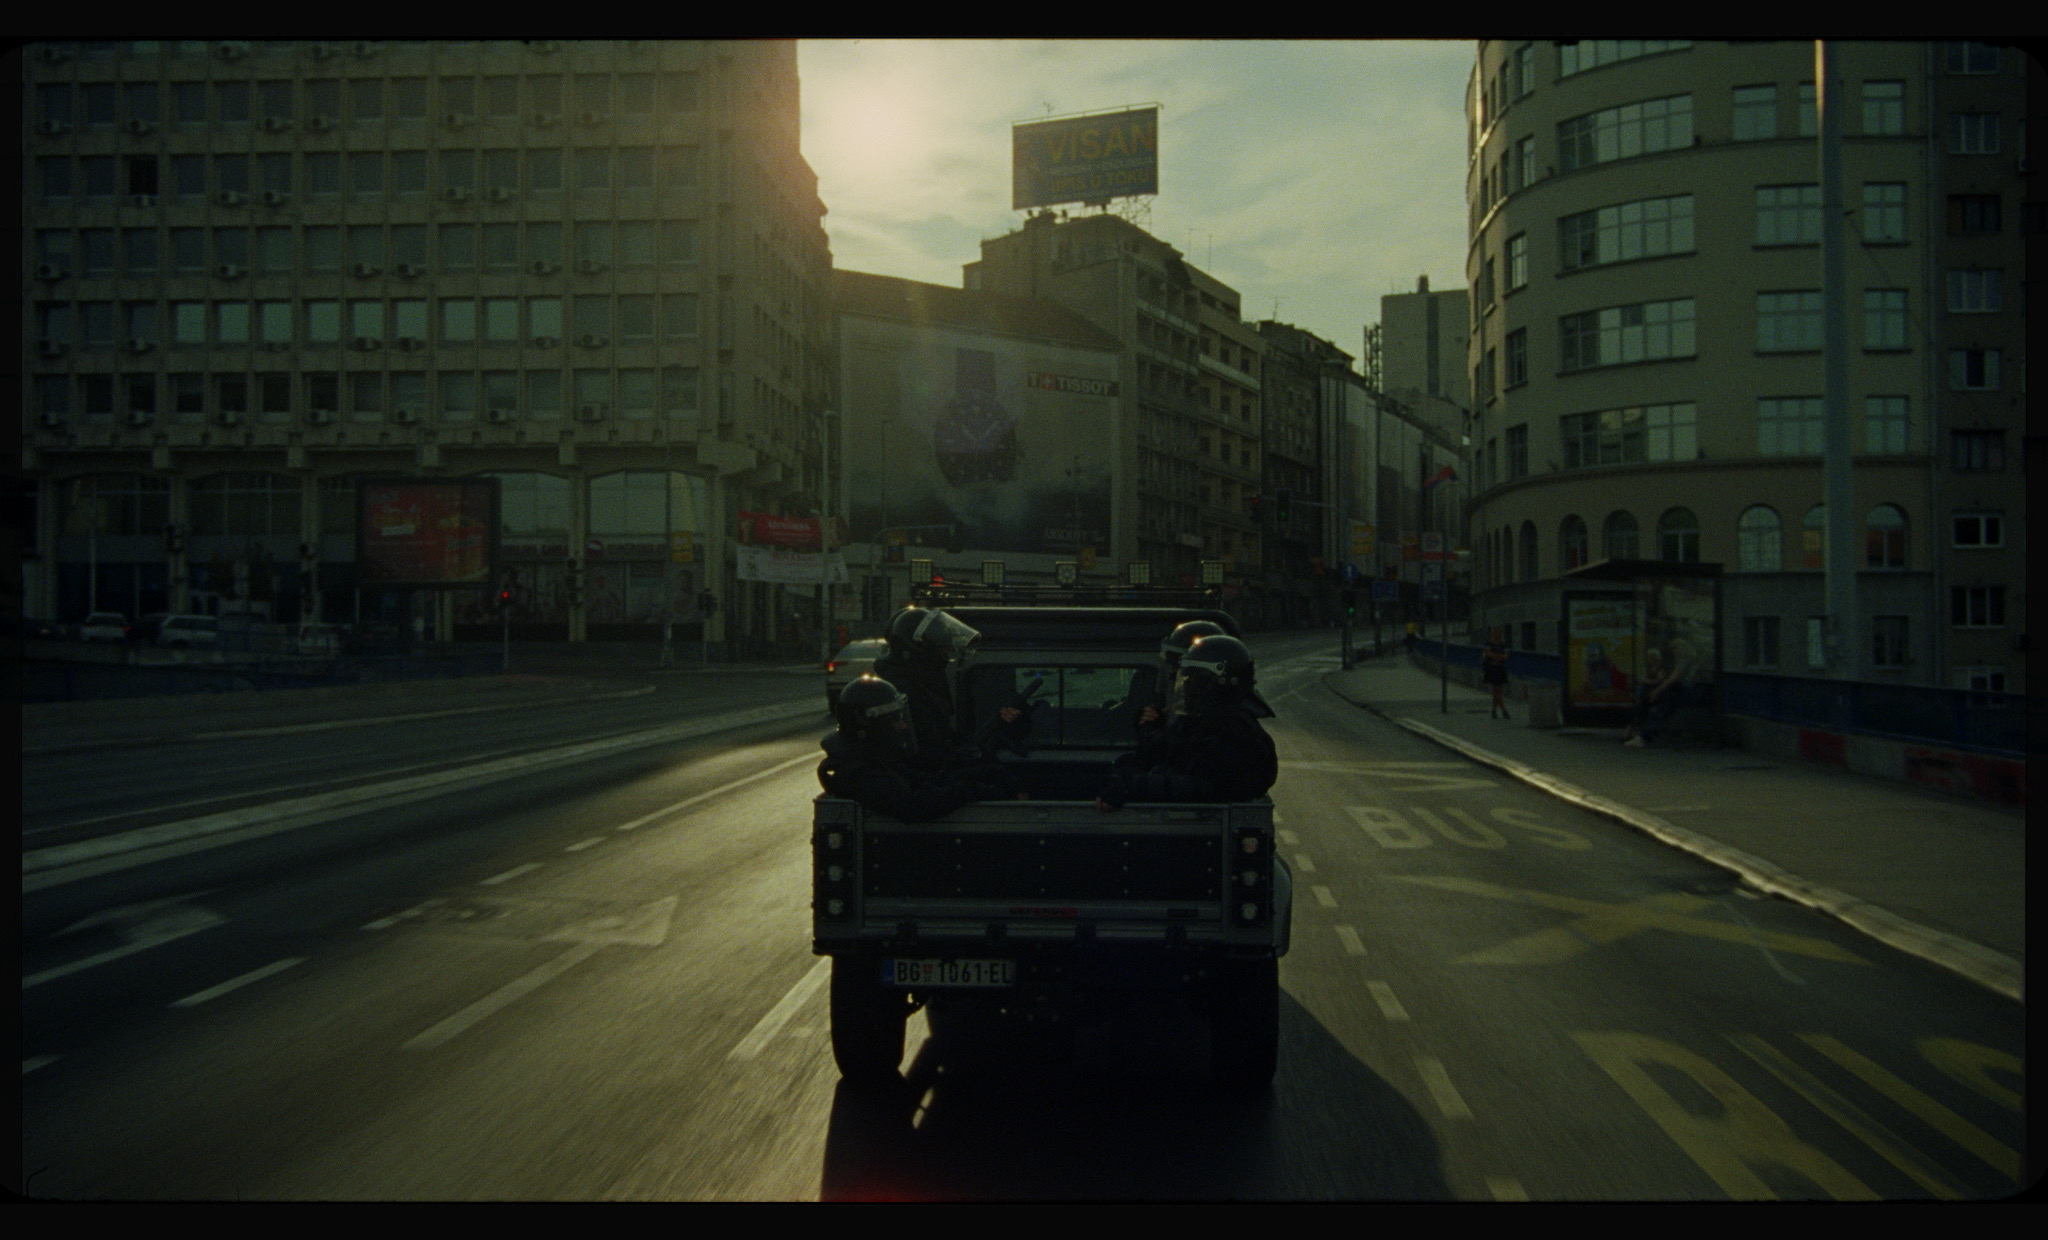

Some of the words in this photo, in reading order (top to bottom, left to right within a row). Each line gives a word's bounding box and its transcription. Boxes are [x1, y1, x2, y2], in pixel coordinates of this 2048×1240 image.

[1046, 122, 1155, 164] VISAN
[1106, 169, 1151, 187] TOKU
[1056, 376, 1112, 395] TISSOT
[1344, 805, 1594, 851] BUS
[897, 962, 921, 982] BG
